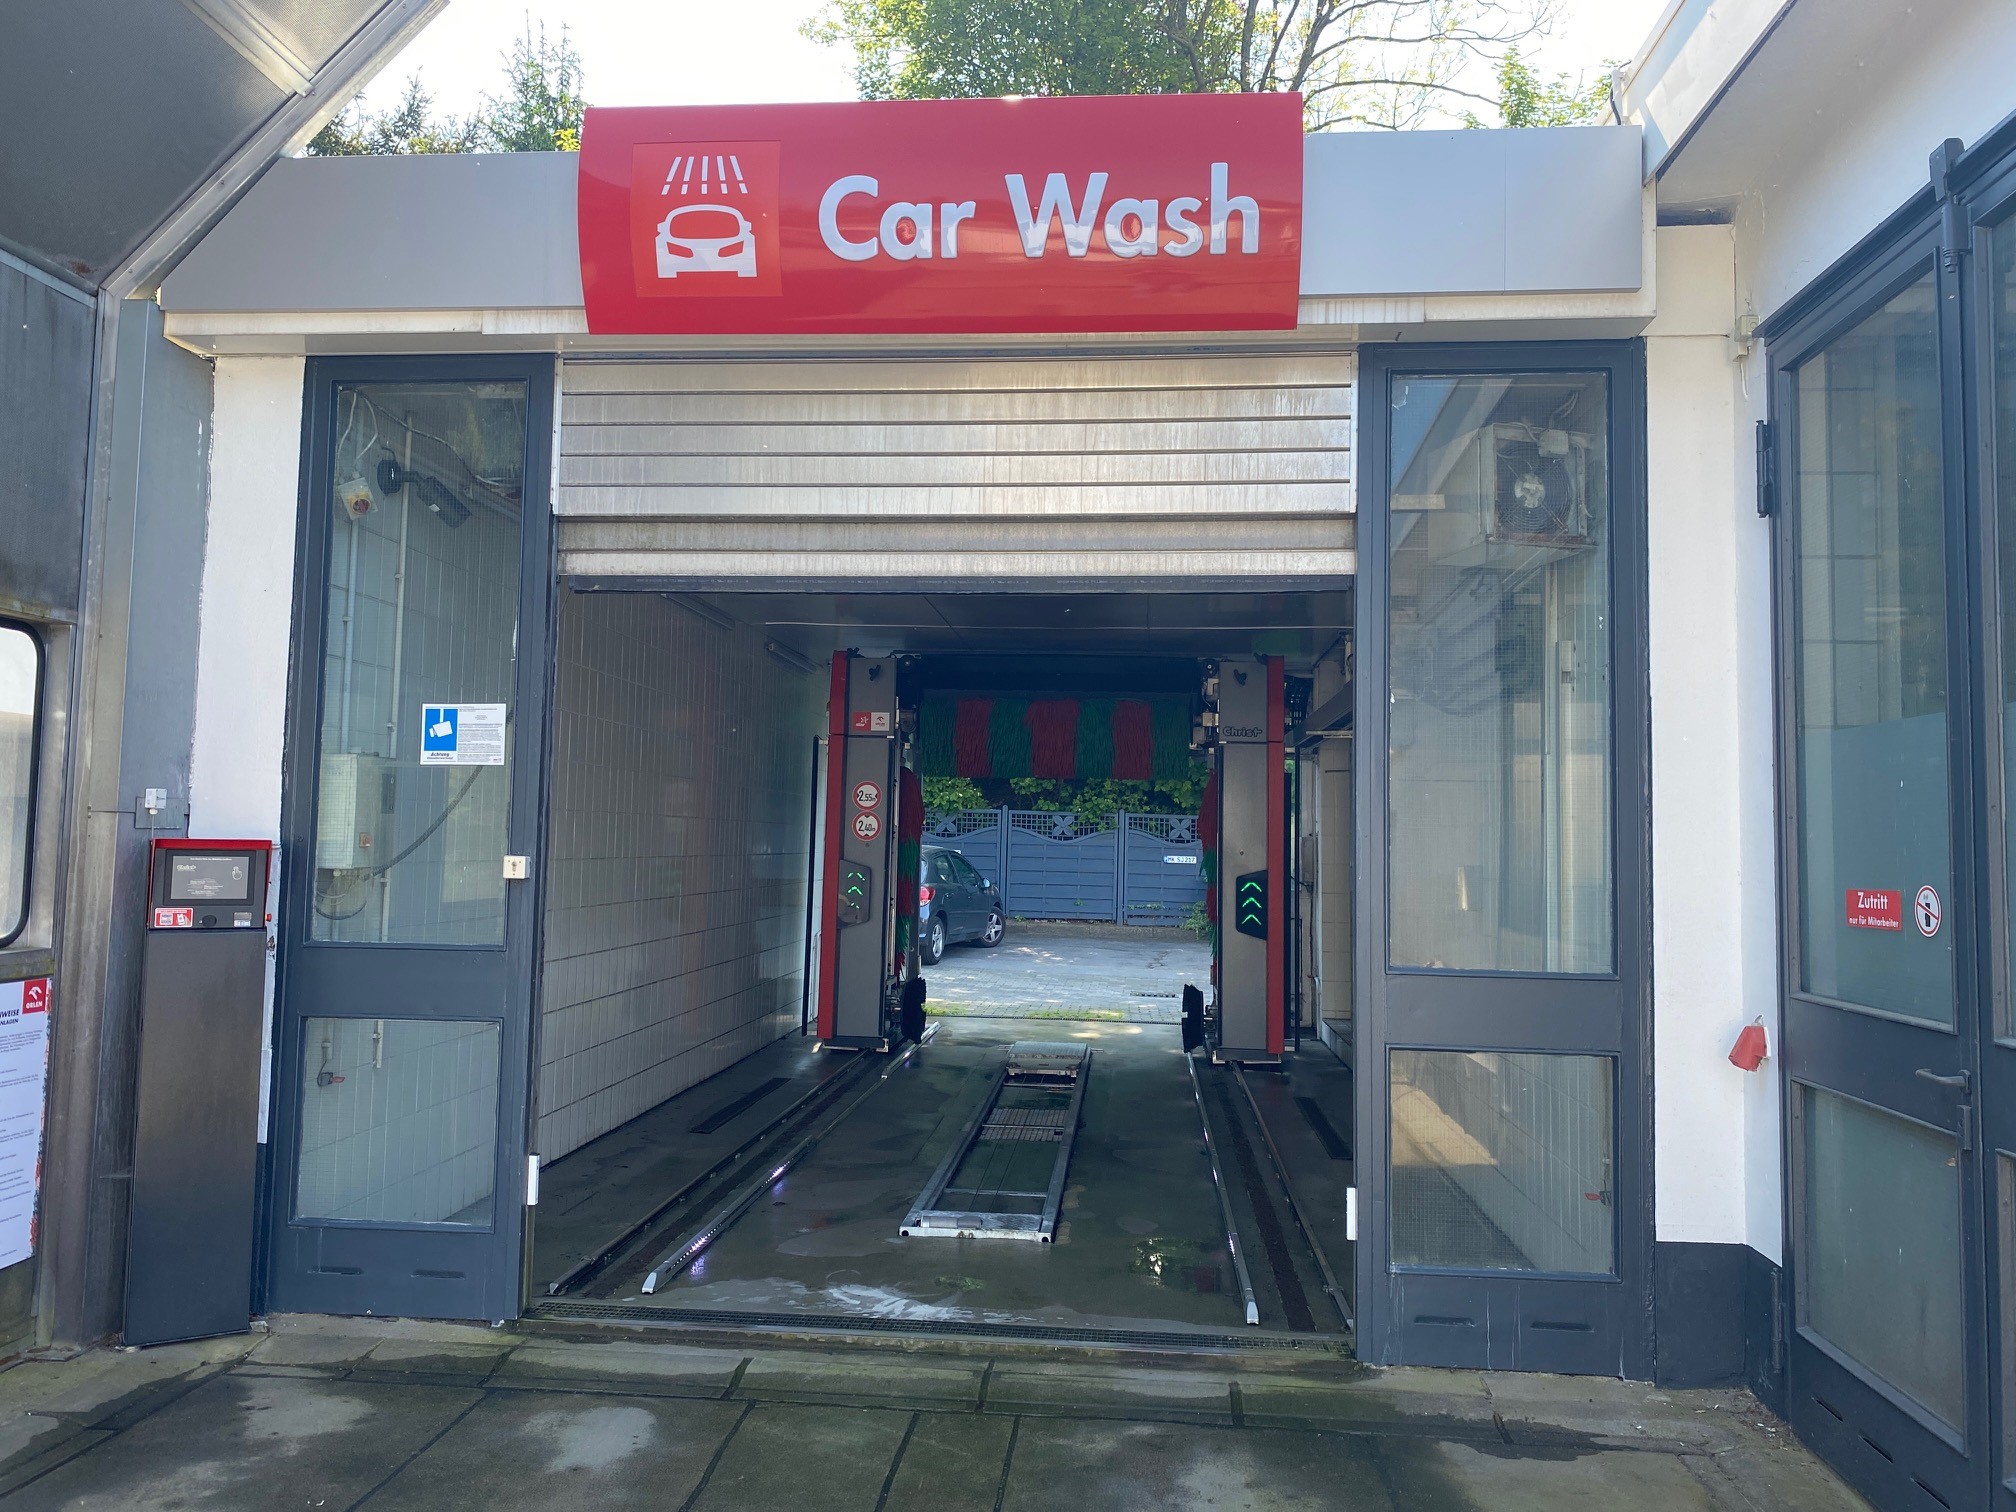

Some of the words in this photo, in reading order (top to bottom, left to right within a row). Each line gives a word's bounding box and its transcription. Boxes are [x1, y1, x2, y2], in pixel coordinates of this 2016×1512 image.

[818, 174, 976, 261] Car
[1004, 162, 1260, 258] Wash
[1222, 726, 1262, 737] Christ
[1857, 891, 1888, 910] Zutritt
[1849, 917, 1858, 925] nur
[1858, 915, 1867, 926] für
[1867, 916, 1899, 928] Mitarbeiter
[25, 1001, 43, 1009] ORLEN
[0, 1009, 19, 1019] WEISE
